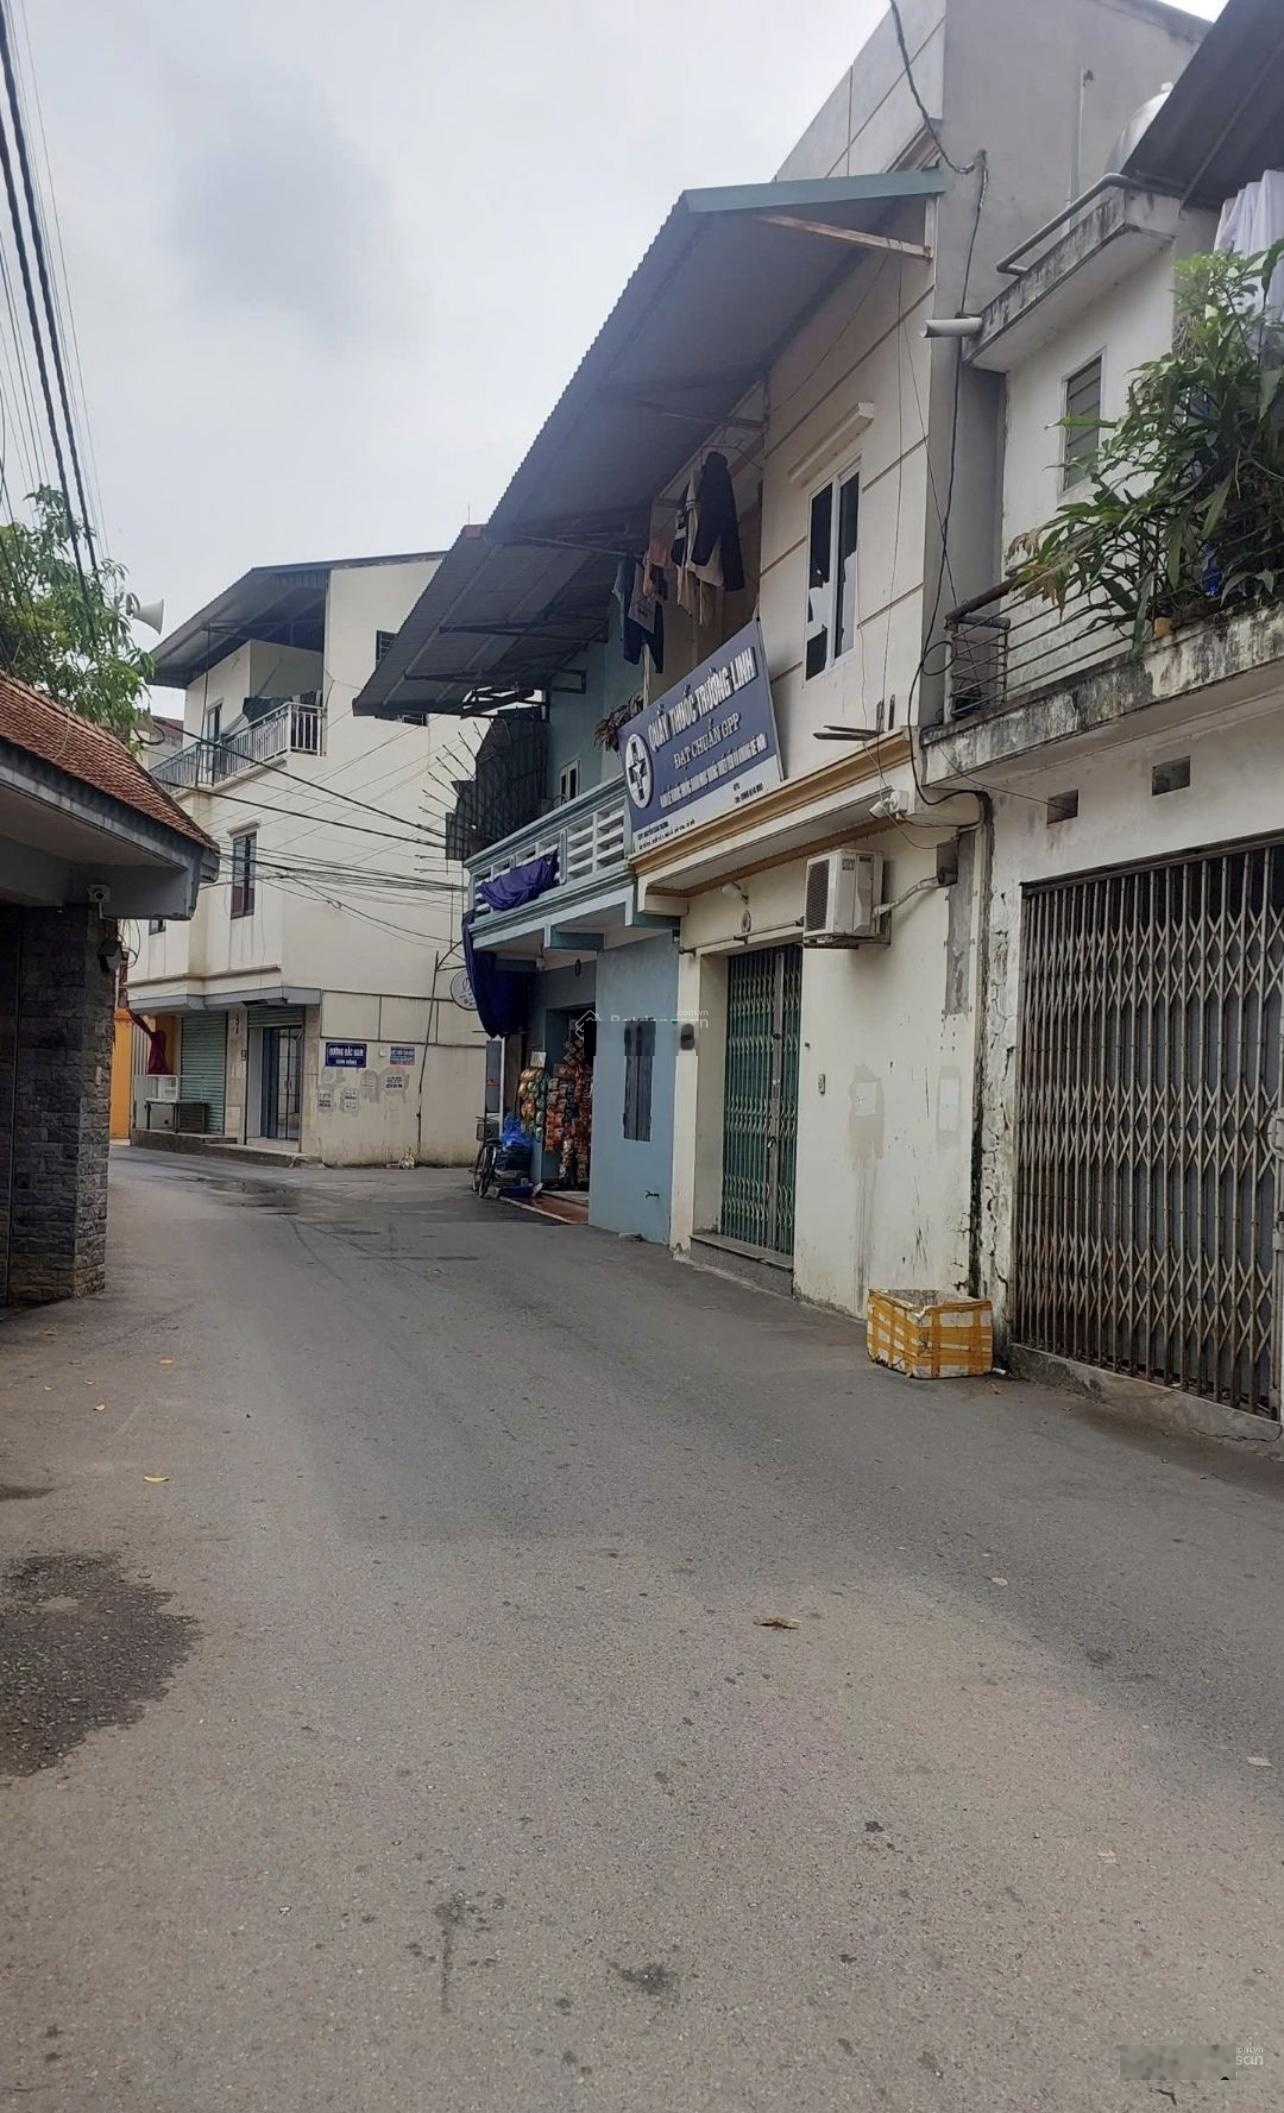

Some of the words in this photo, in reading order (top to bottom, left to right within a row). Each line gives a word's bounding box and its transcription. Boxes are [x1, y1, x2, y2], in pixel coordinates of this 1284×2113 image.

[730, 647, 757, 694] LINH
[690, 718, 720, 760] CHUẨN
[720, 714, 741, 742] GPP
